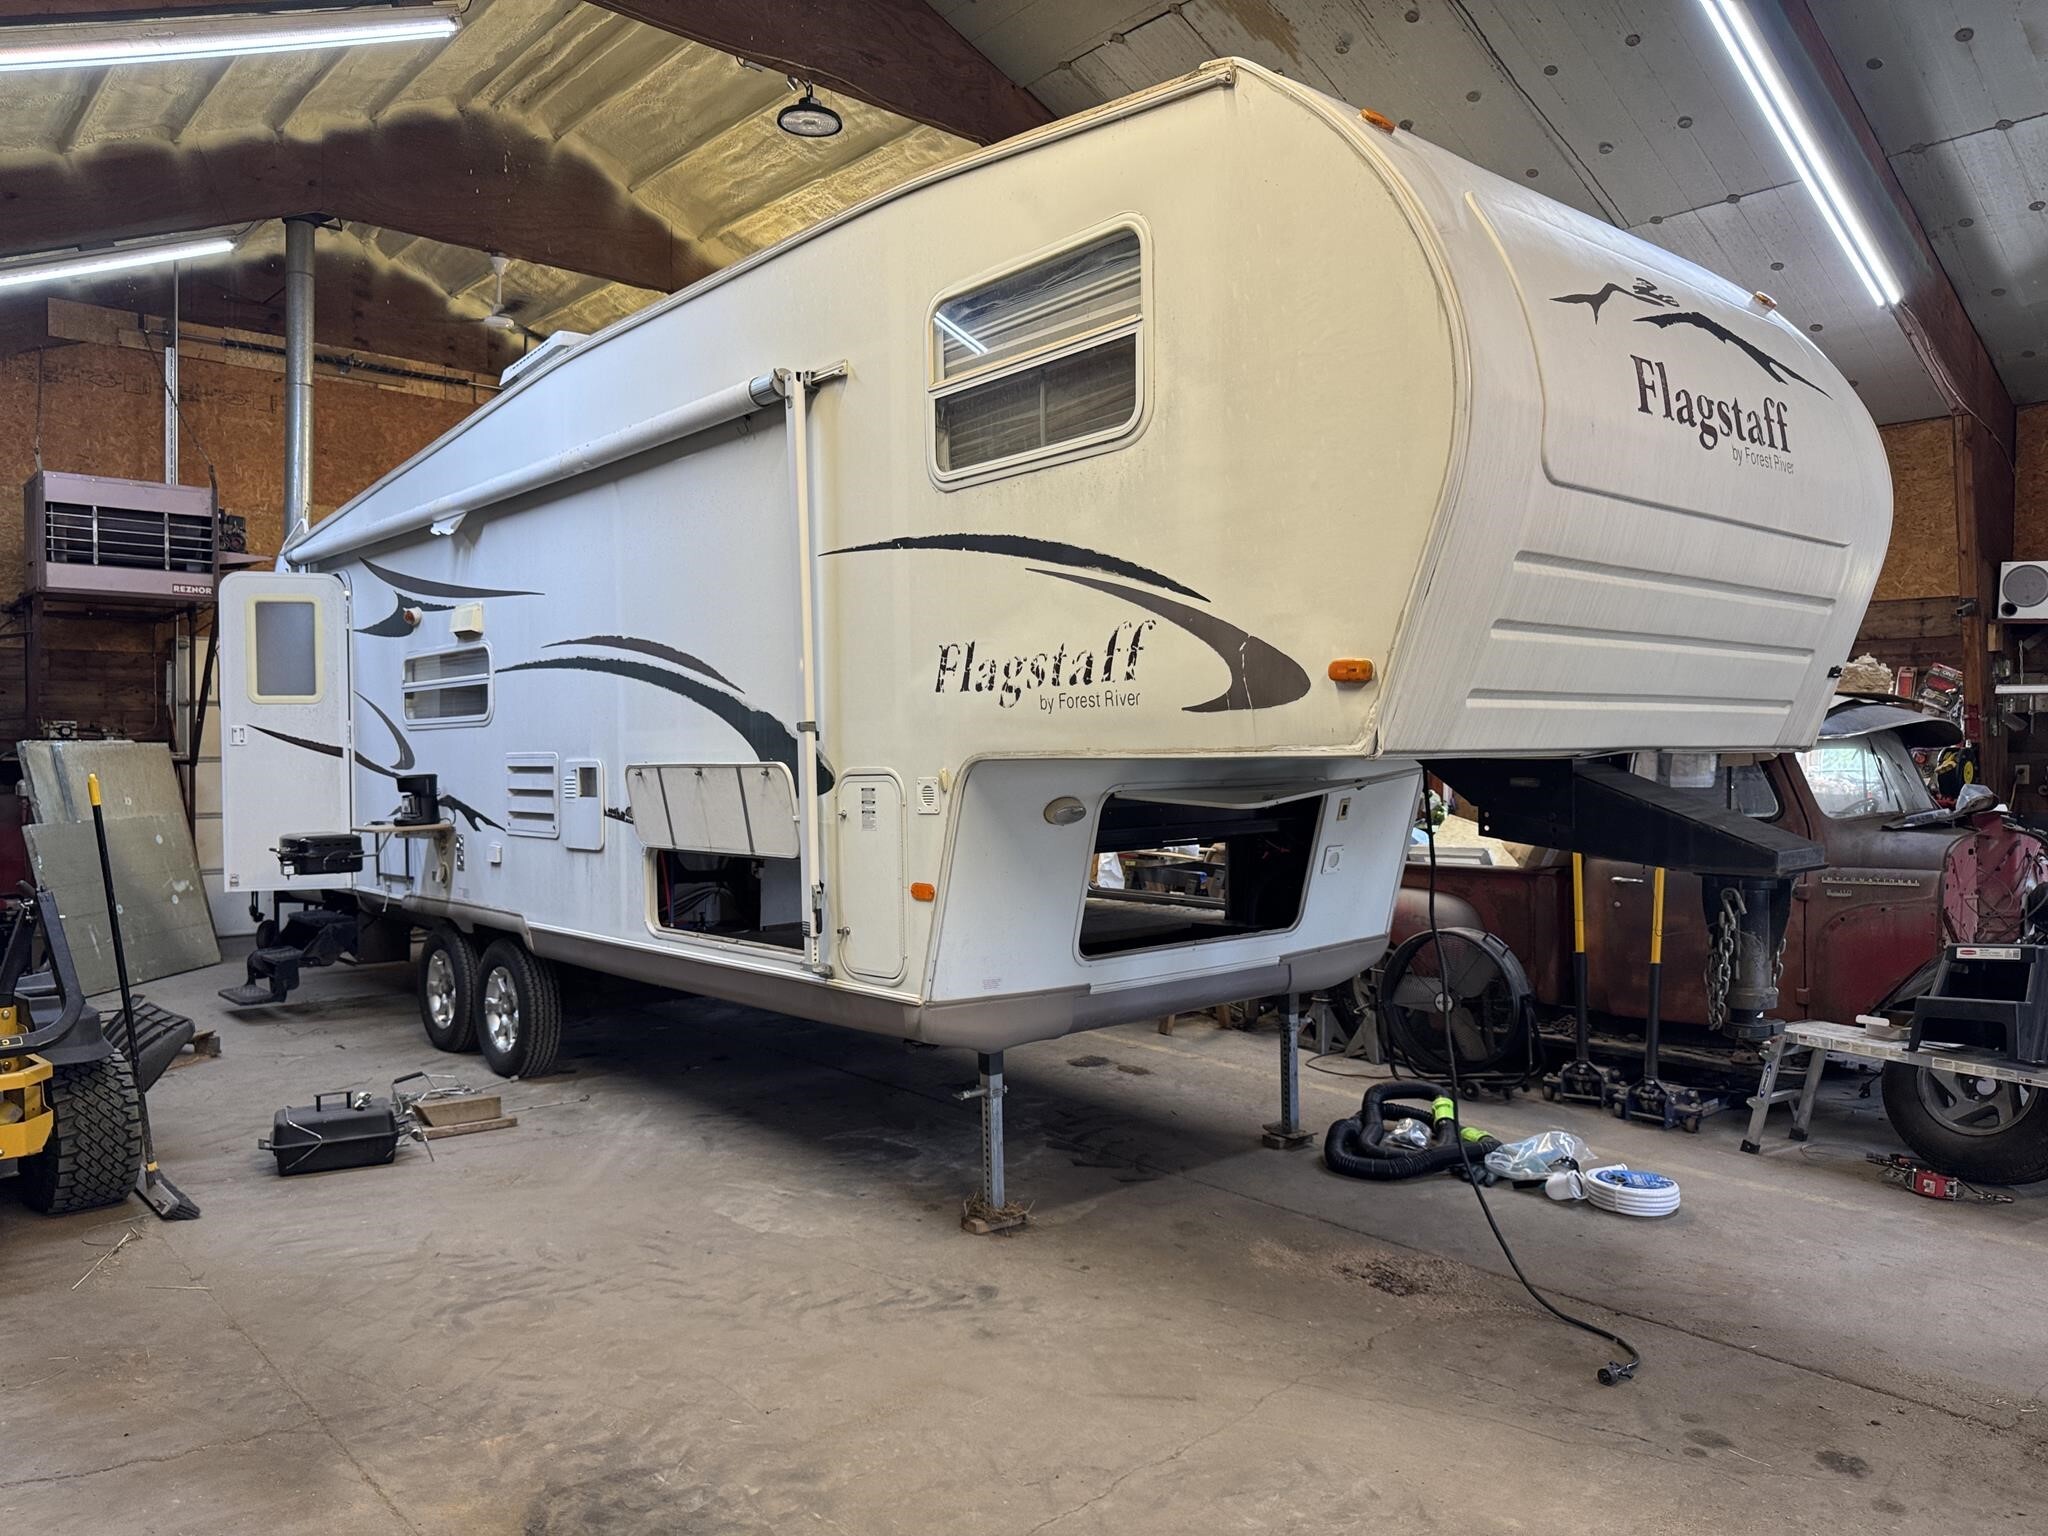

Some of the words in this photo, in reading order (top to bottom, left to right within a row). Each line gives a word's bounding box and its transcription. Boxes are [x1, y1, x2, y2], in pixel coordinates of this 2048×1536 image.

[1630, 354, 1792, 453] Flagstaff
[1731, 445, 1744, 466] by
[1744, 447, 1774, 470] Forest
[1774, 455, 1795, 475] River
[173, 585, 213, 595] REZNOR
[935, 619, 1157, 709] Flagstaff
[1039, 694, 1055, 714] by
[1058, 692, 1101, 709] Forest
[1104, 689, 1141, 707] River
